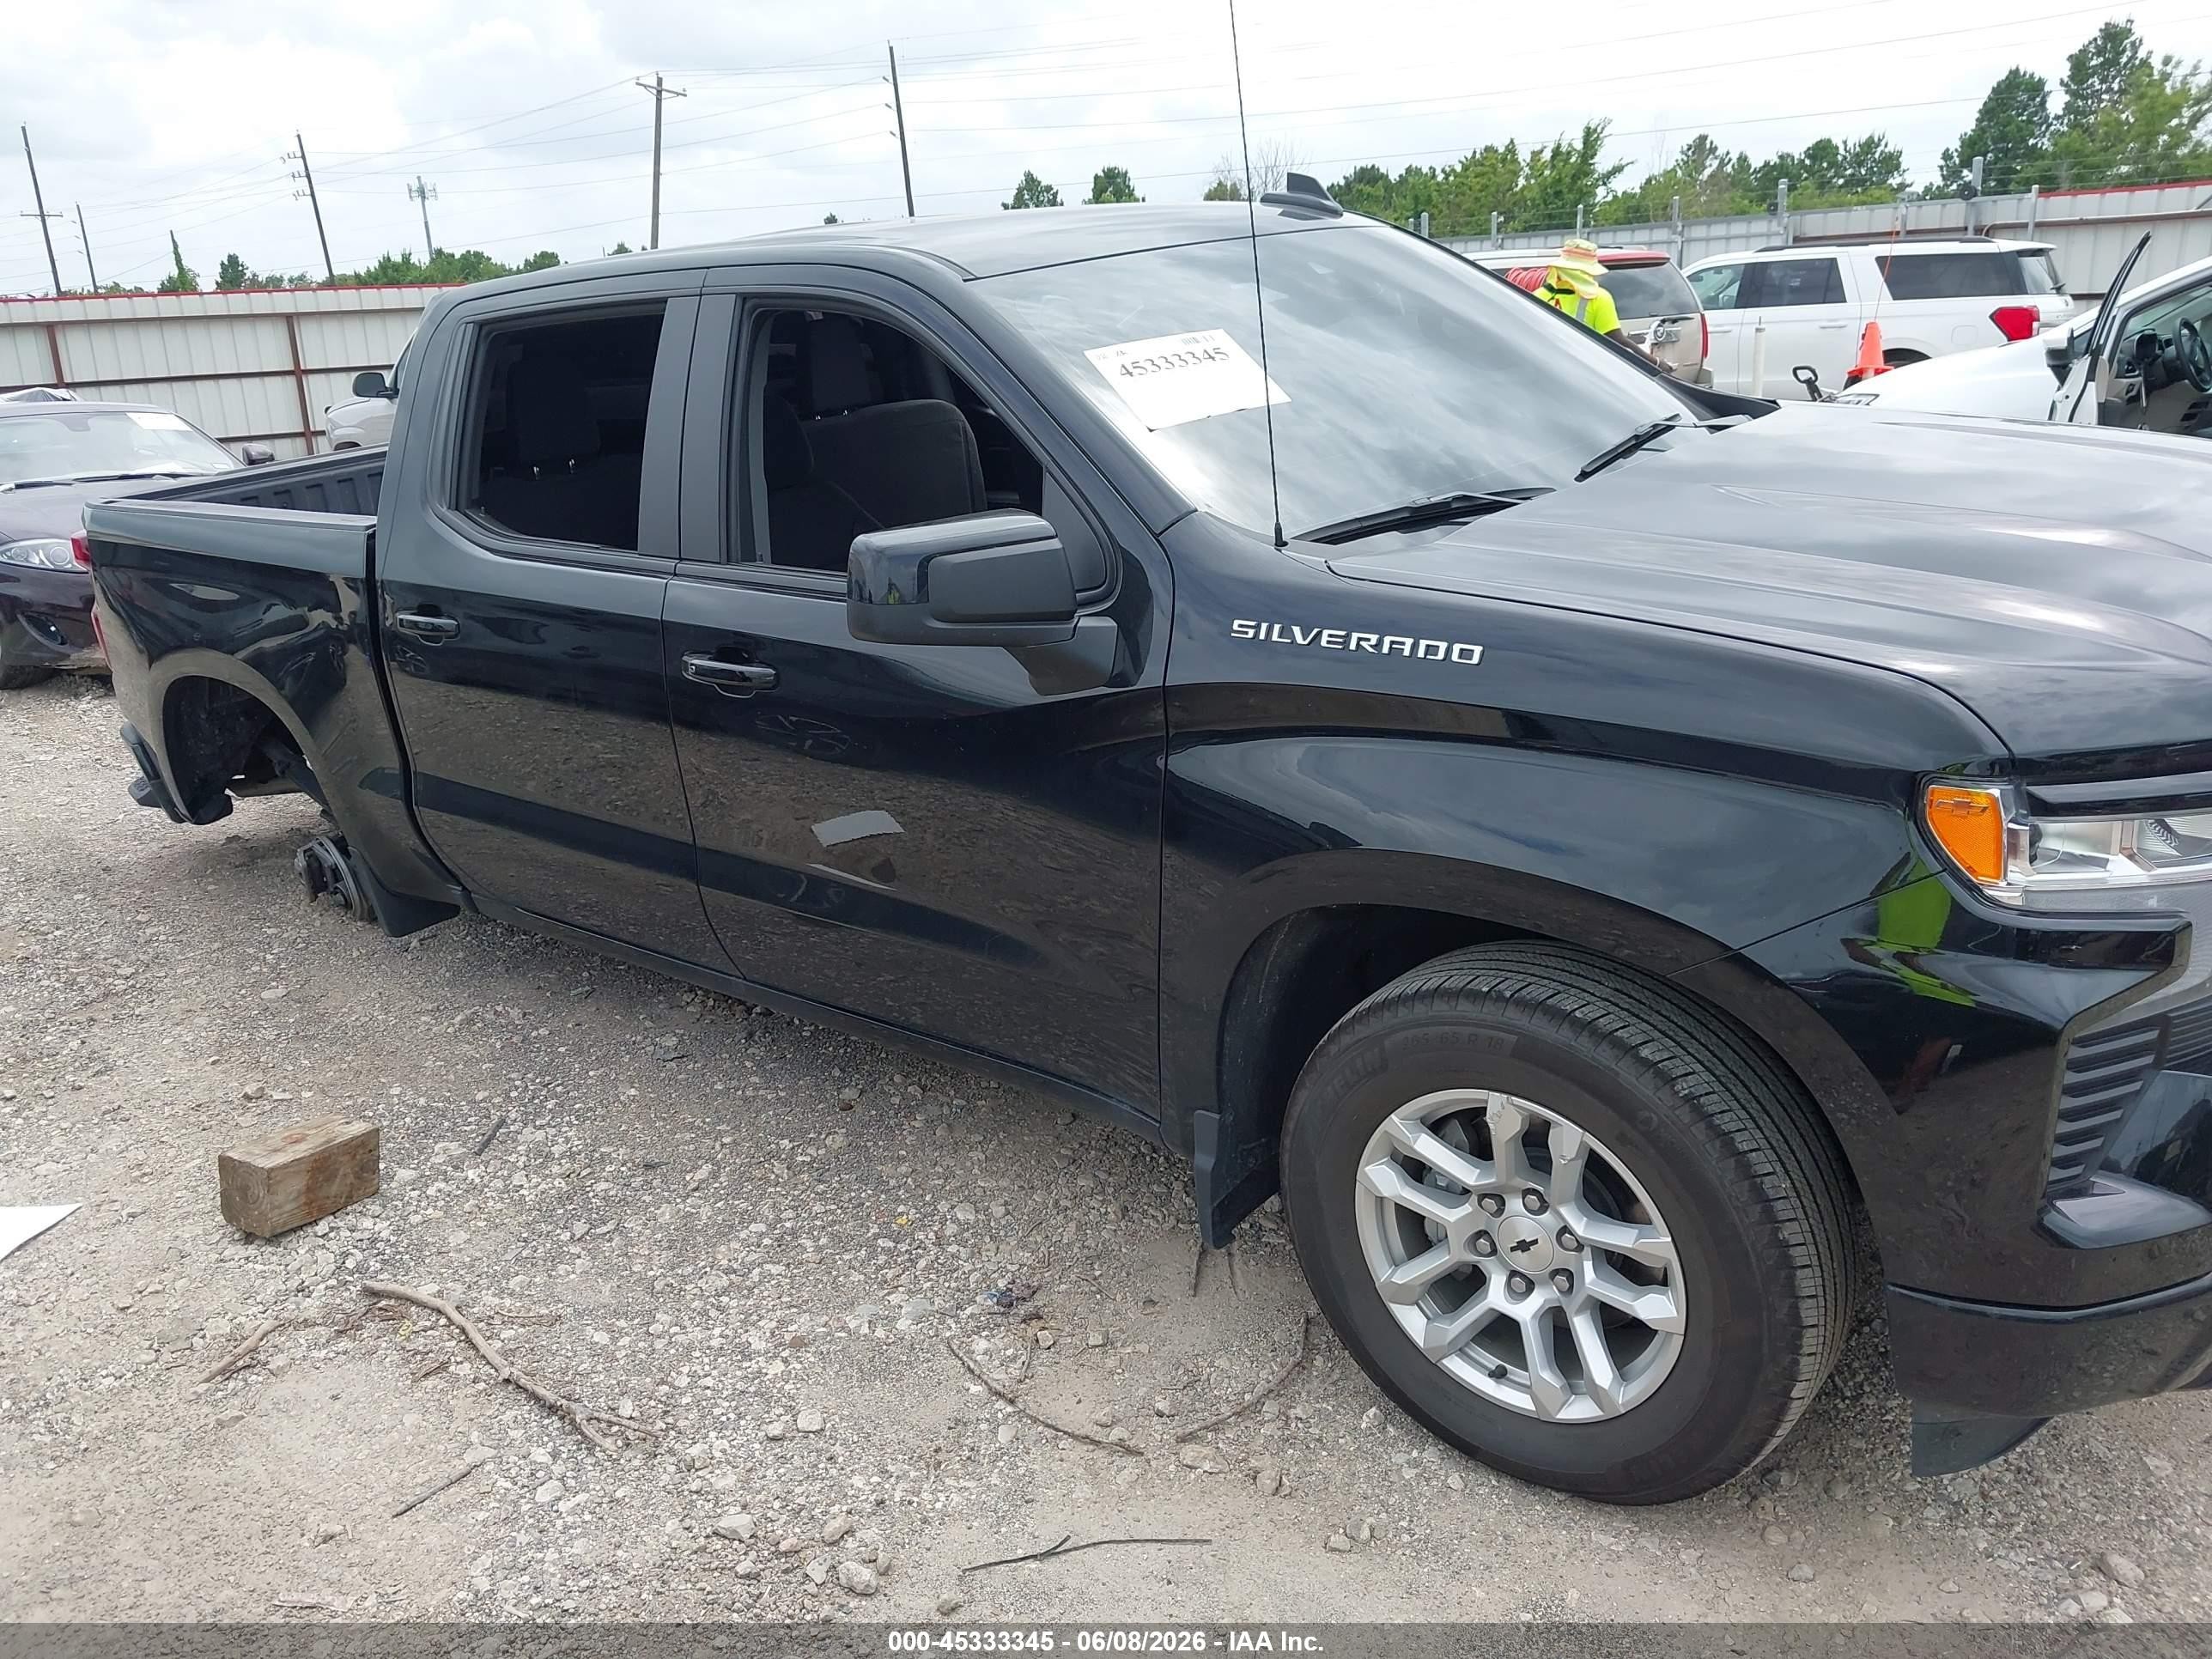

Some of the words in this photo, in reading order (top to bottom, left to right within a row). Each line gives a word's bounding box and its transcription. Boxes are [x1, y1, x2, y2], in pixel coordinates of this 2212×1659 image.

[1119, 347, 1230, 378] 45333345
[1230, 618, 1485, 665] SILVERADO
[1467, 1032, 1479, 1045] R
